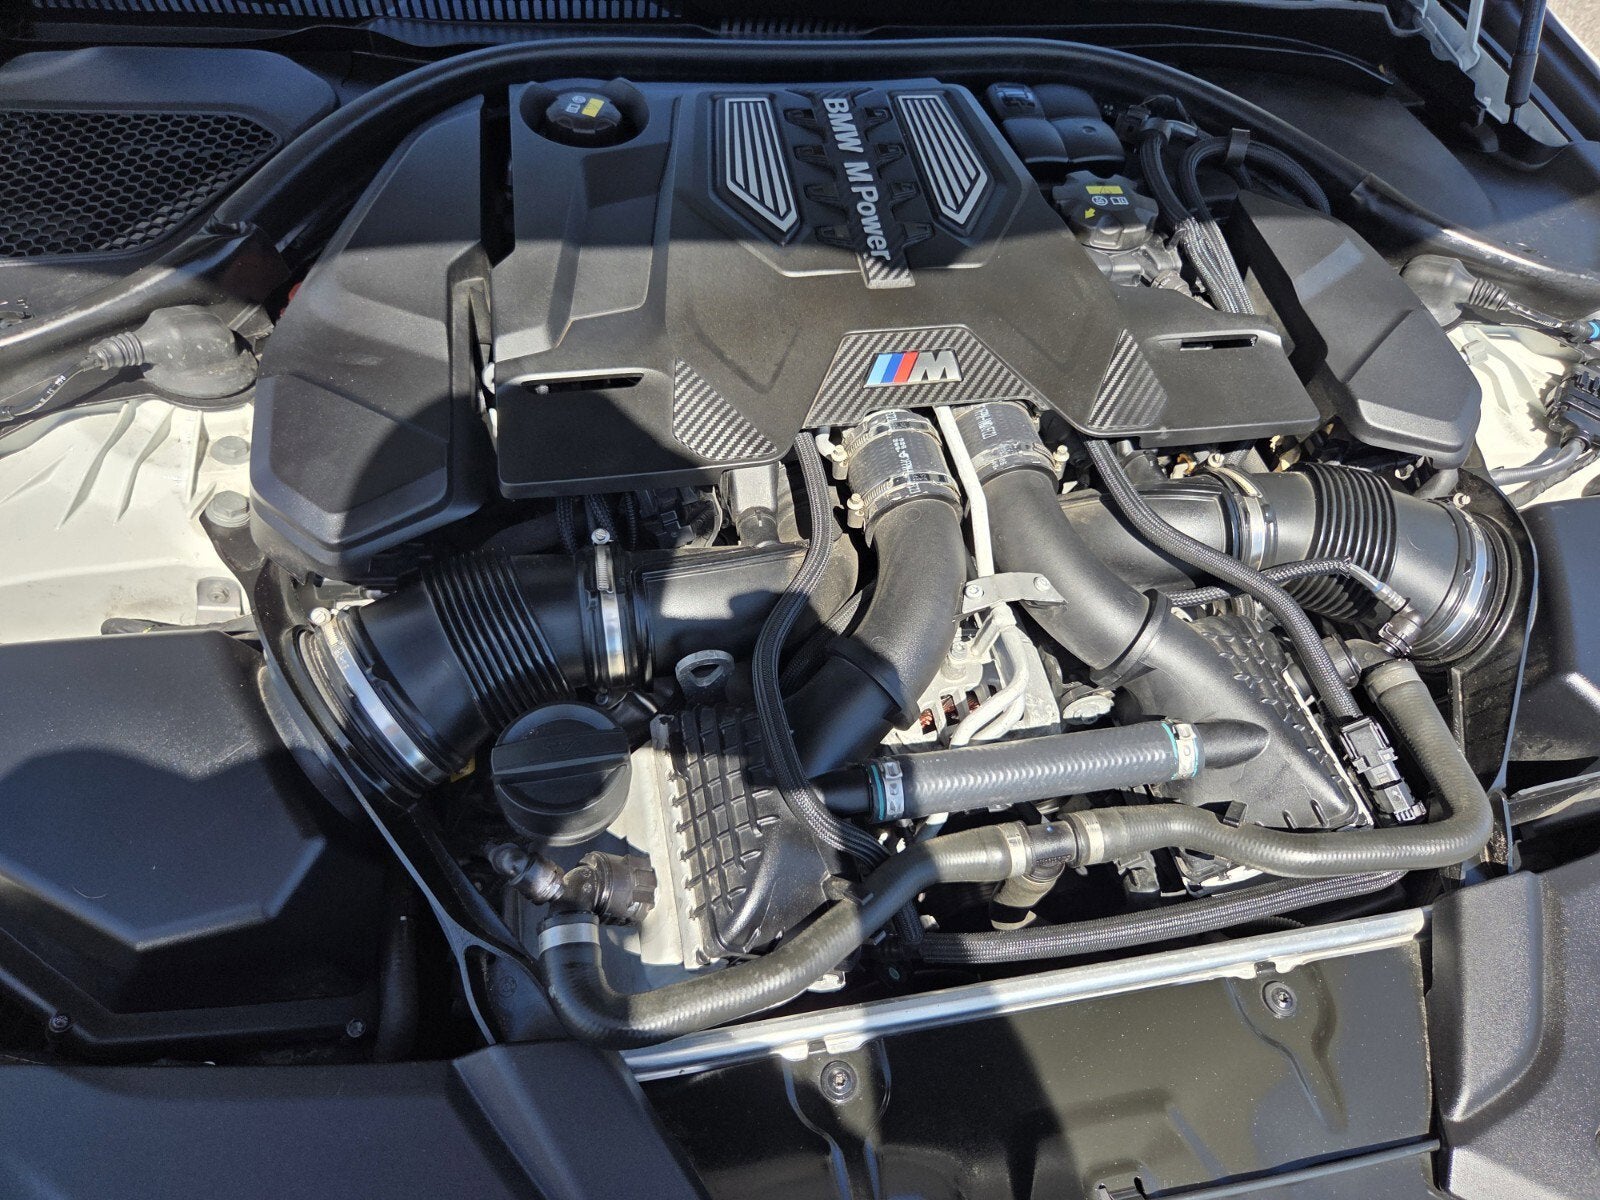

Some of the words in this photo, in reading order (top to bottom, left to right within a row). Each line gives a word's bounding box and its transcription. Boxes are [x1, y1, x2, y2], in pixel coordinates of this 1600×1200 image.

[823, 98, 864, 153] BMW
[843, 161, 874, 183] M
[850, 185, 891, 261] Power
[907, 350, 963, 382] M
